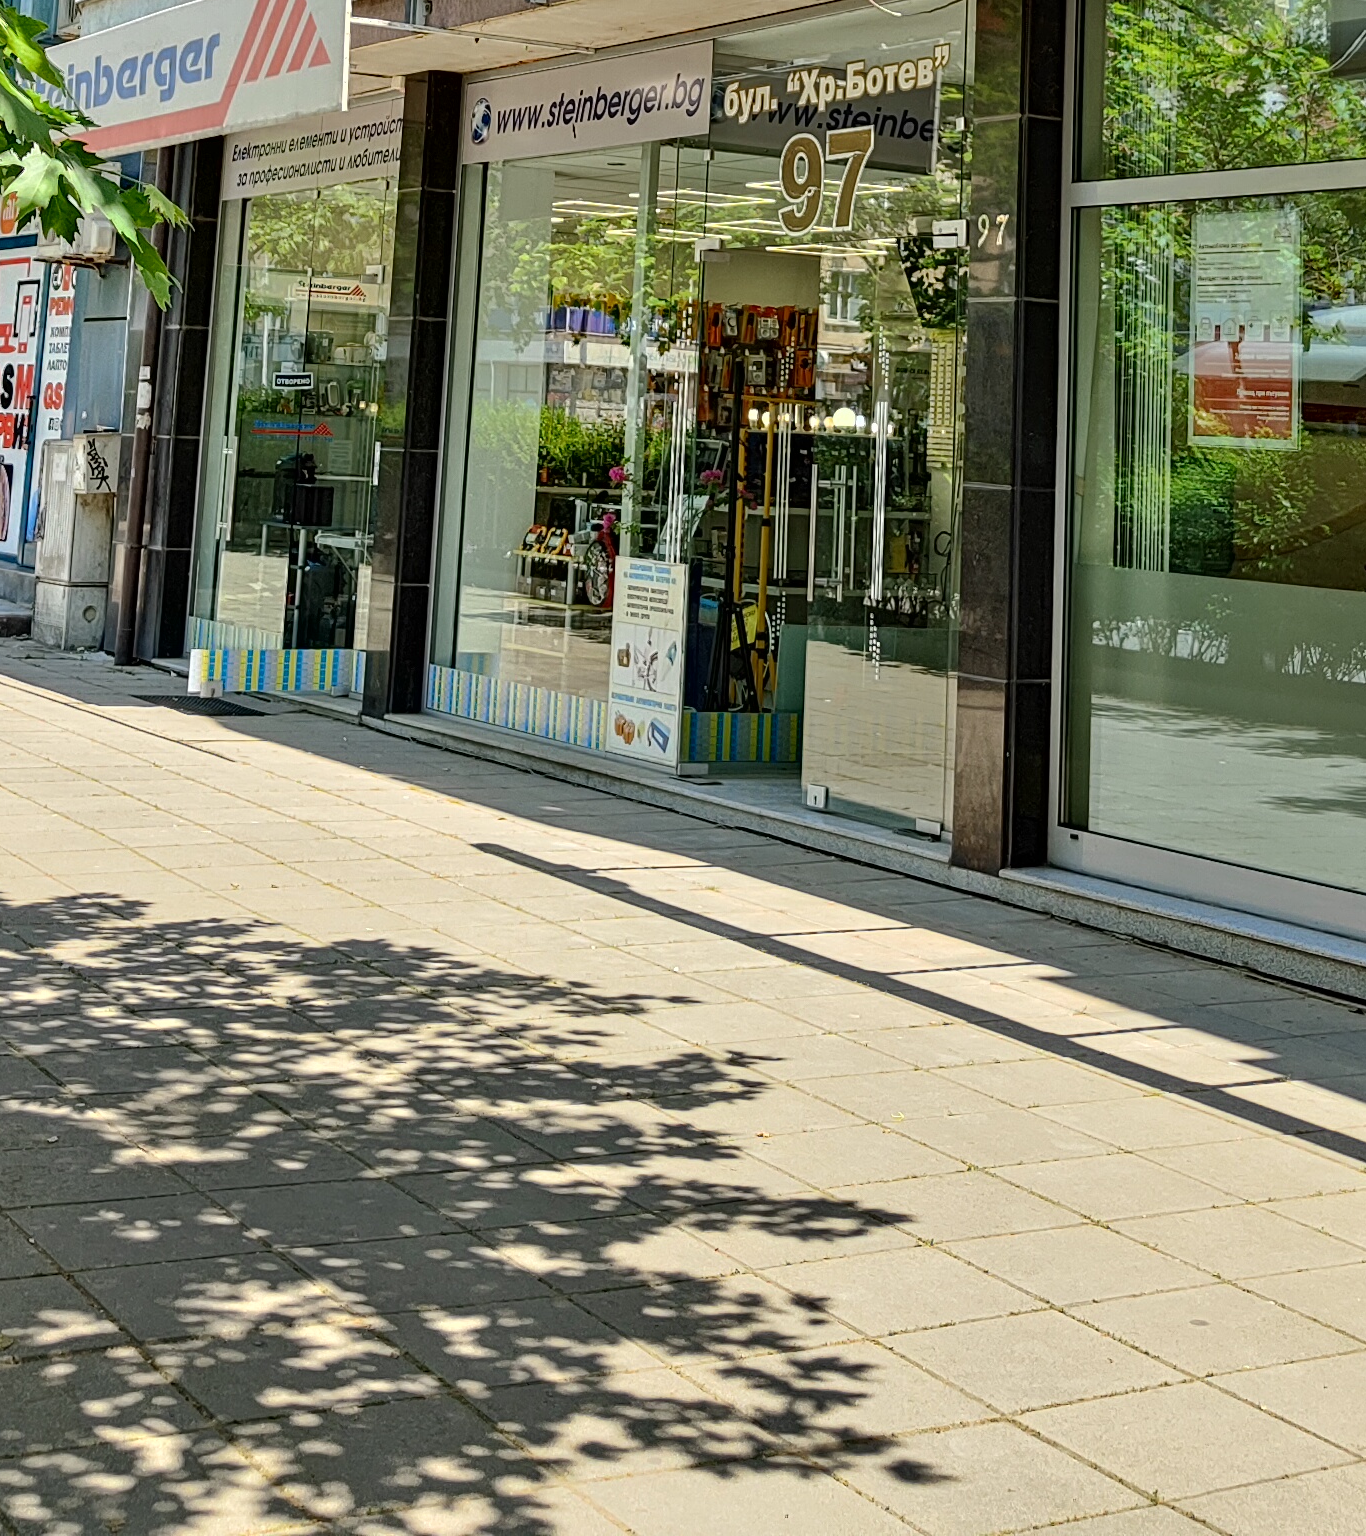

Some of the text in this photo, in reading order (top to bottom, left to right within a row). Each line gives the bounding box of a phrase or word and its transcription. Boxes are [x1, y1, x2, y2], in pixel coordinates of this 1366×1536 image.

[497, 73, 705, 135] www.steinberger.bg
[724, 81, 779, 124] бул.
[232, 140, 288, 162] Електронни
[288, 130, 339, 152] елементи
[340, 128, 348, 143] и
[237, 172, 248, 187] за
[248, 158, 337, 188] професионалисти
[338, 157, 346, 171] и
[778, 124, 875, 238] 97
[976, 213, 1010, 249] 97
